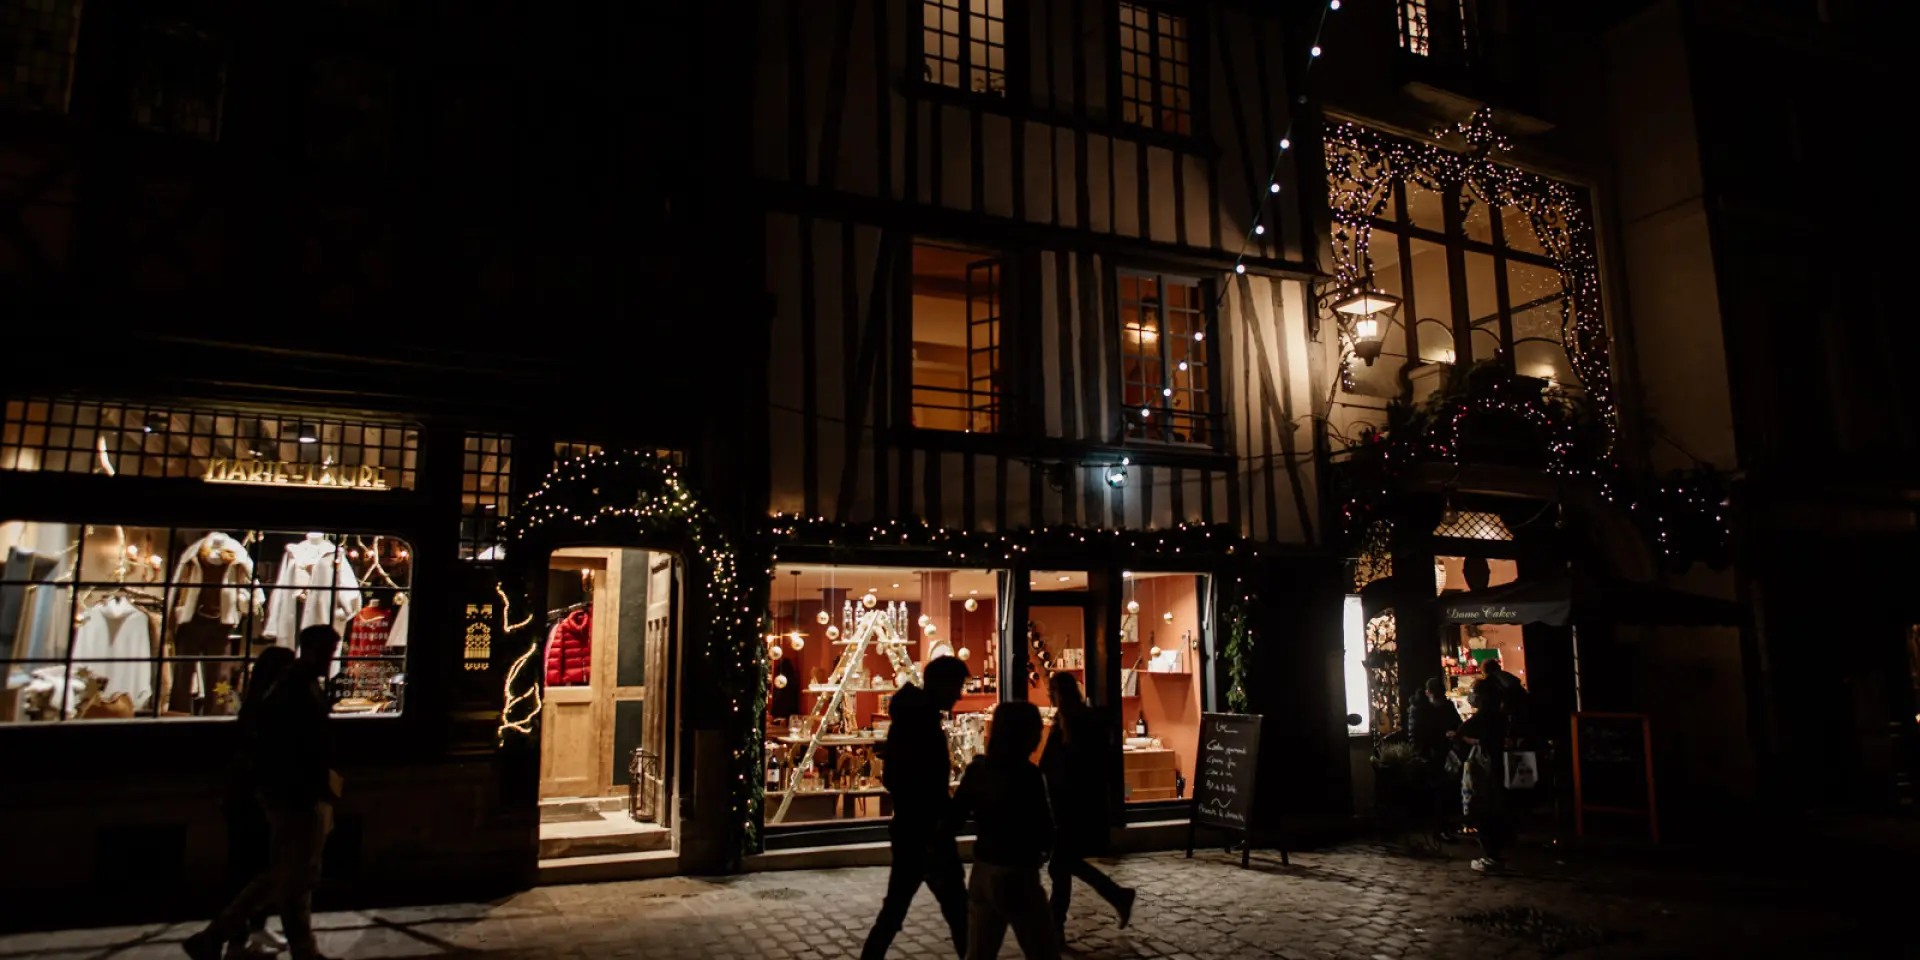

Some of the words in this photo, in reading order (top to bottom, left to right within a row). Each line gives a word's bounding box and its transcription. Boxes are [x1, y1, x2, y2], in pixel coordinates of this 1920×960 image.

[205, 457, 387, 488] MARIE-LAURE
[1446, 607, 1480, 619] Dame
[1481, 605, 1517, 619] Cakes
